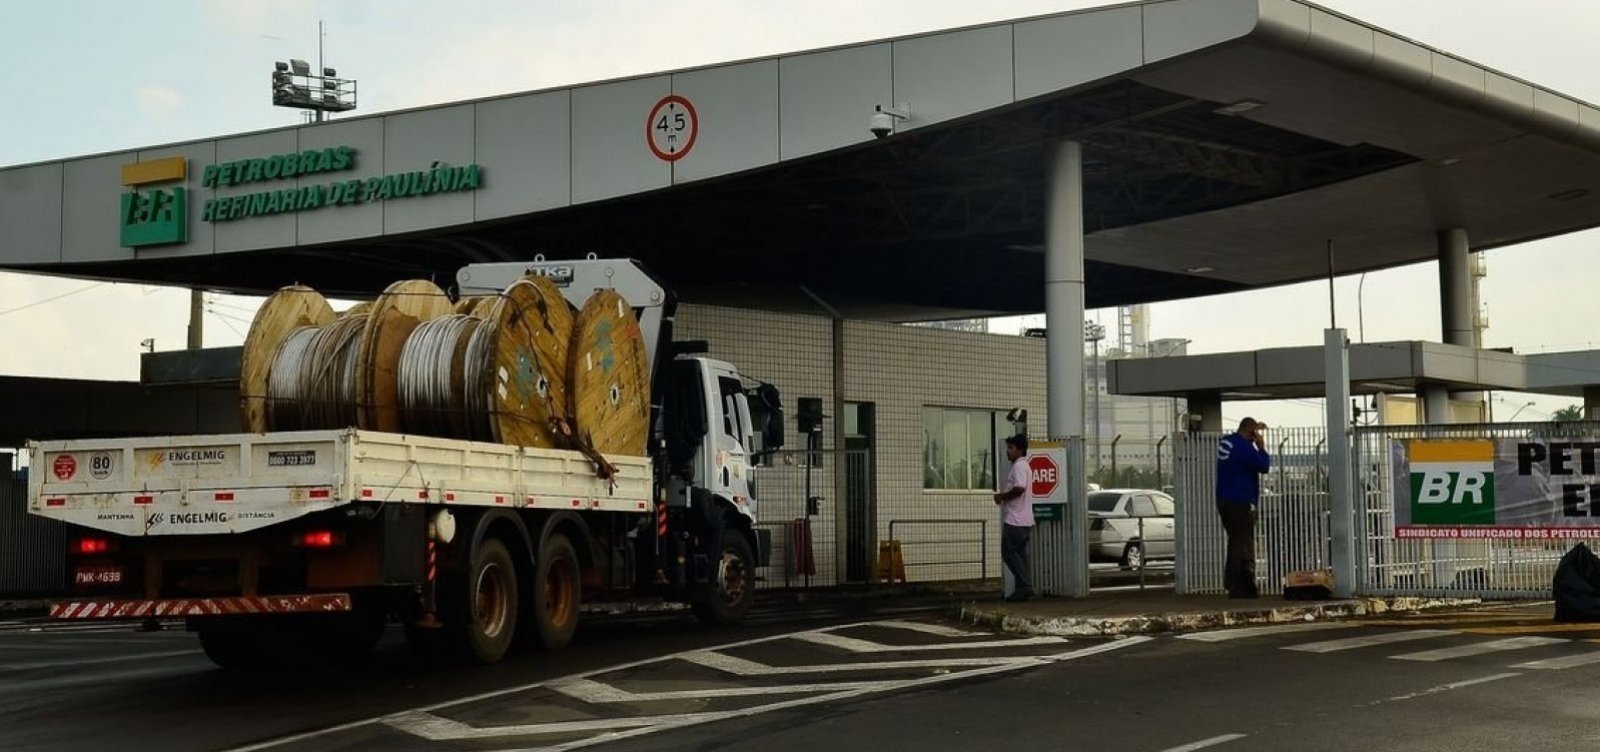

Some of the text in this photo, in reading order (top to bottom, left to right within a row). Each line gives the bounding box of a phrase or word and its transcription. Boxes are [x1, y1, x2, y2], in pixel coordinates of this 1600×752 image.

[667, 134, 677, 143] m
[201, 147, 355, 187] PETROBRAS
[201, 160, 480, 222] REFINARIA DE PAULÍNIA
[169, 450, 225, 461] ENGELMIG
[1518, 442, 1600, 476] PET
[93, 456, 110, 470] 80
[1032, 468, 1056, 483] ARE
[1417, 471, 1485, 504] BR
[170, 512, 227, 524] ENGELMIG
[1399, 528, 1458, 538] SINDICATO
[1460, 528, 1522, 538] UNIFICADO
[1524, 528, 1549, 538] DOS
